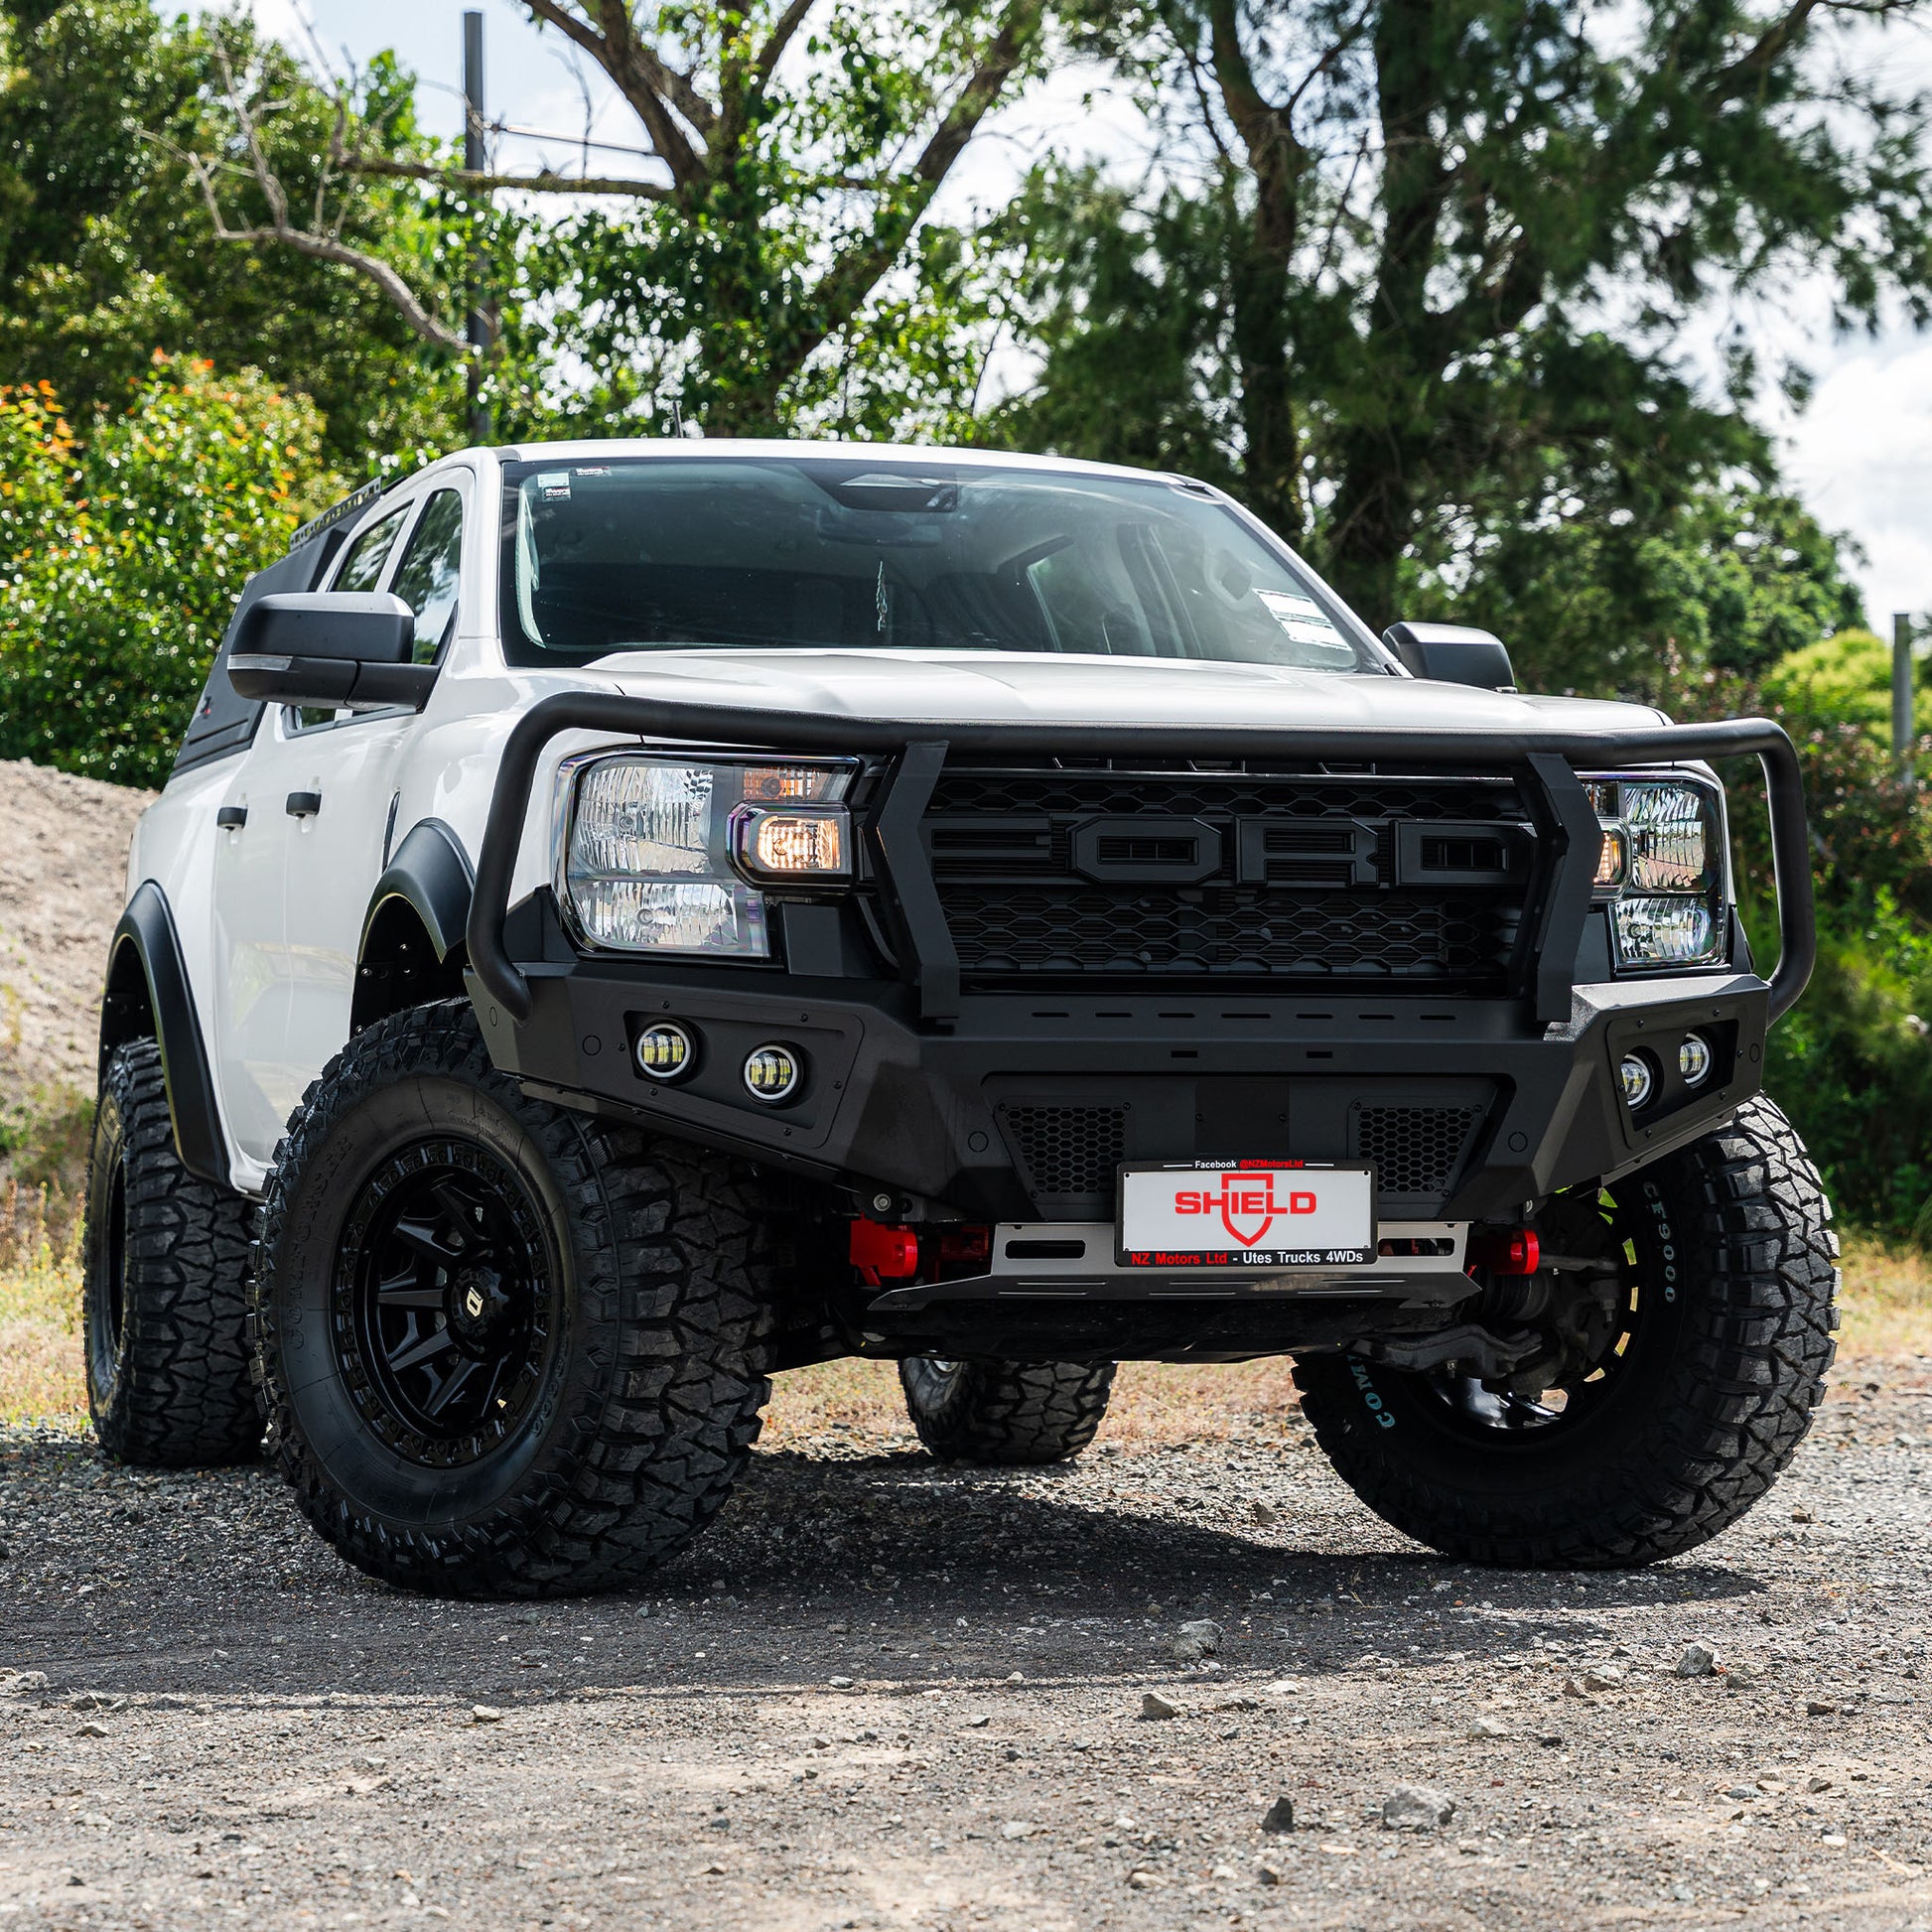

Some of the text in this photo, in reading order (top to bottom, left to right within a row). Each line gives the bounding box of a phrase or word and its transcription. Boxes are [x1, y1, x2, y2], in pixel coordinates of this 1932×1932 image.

[1194, 1159, 1304, 1170] Facebook @NZMotorsLtd
[1174, 1191, 1317, 1214] SHIELD
[1642, 1180, 1676, 1303] CF9000
[1131, 1252, 1151, 1265] NZ
[1155, 1252, 1201, 1265] Motors
[1205, 1252, 1228, 1265] Ltd
[1242, 1251, 1273, 1264] Utes
[1277, 1251, 1321, 1263] Trucks
[1325, 1250, 1364, 1263] 4WDs
[1346, 1355, 1397, 1428] COM
